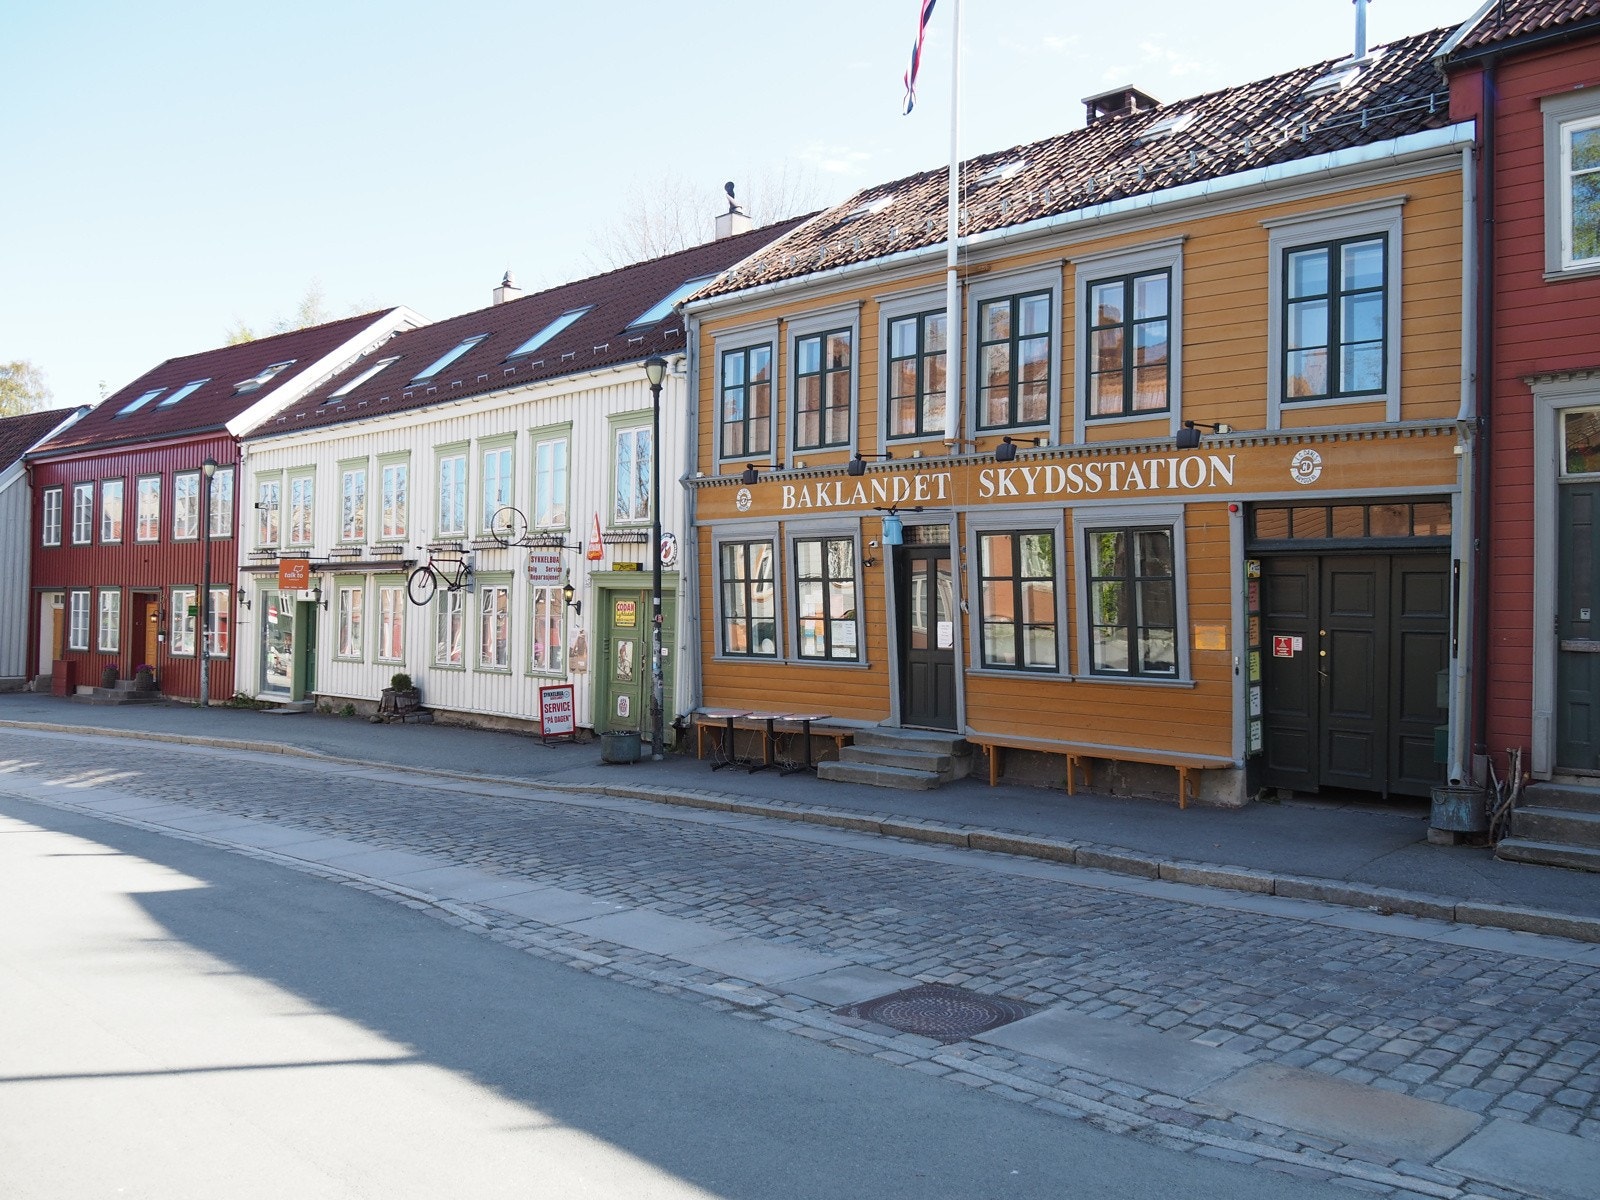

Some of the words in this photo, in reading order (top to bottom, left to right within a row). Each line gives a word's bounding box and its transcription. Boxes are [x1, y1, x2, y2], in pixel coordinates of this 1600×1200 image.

[781, 472, 951, 510] BAKLANDET
[979, 454, 1235, 498] SKYDSSTATION
[530, 555, 560, 564] SYKKELBUA
[527, 565, 538, 573] Salg
[545, 565, 562, 573] Service
[284, 571, 296, 579] talk
[296, 571, 304, 579] to
[616, 603, 635, 612] CODAN
[543, 701, 571, 714] SERVICE
